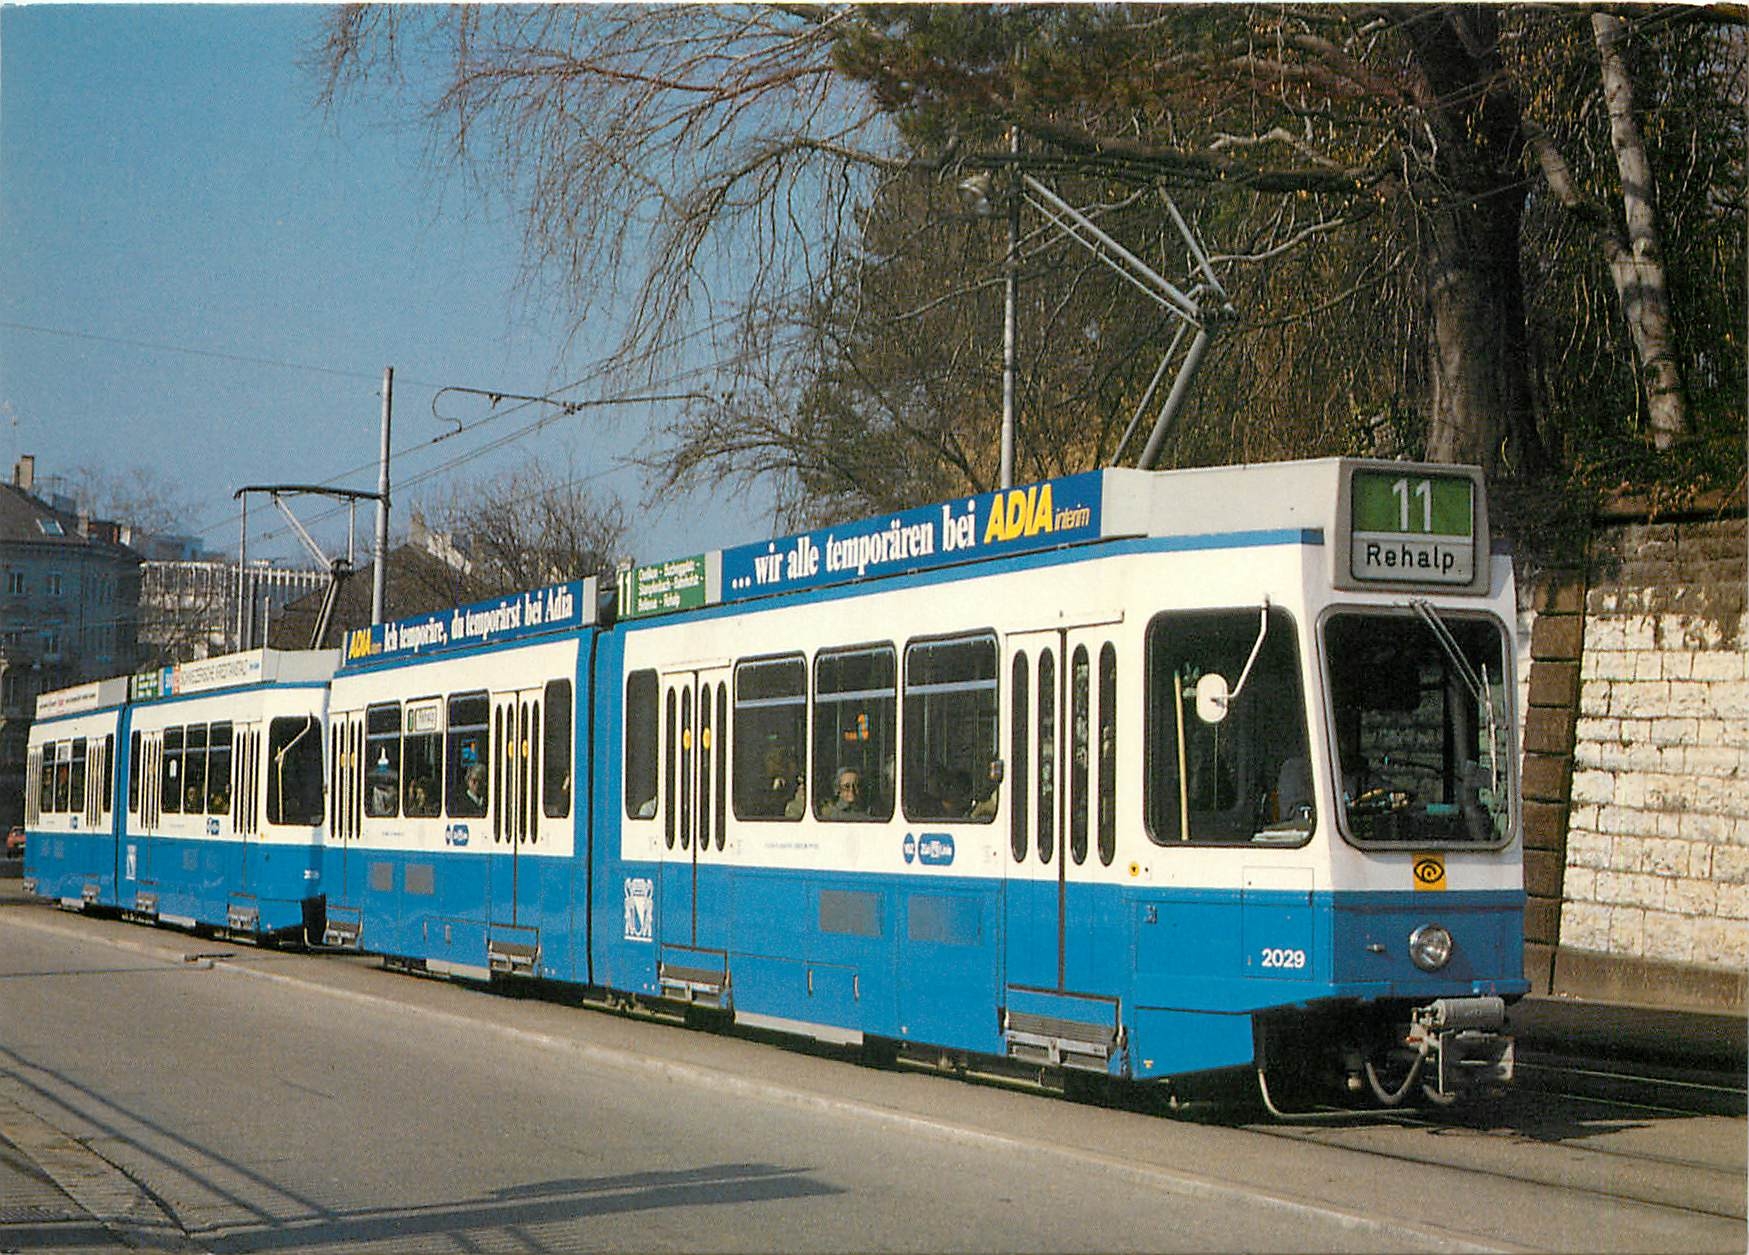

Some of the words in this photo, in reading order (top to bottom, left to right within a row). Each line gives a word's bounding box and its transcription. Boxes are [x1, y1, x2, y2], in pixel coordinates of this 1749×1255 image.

[788, 535, 818, 580] alle
[826, 516, 934, 576] temporären
[942, 500, 976, 552] bei
[984, 483, 1053, 544] ADIA
[1054, 503, 1091, 531] interim
[1392, 478, 1431, 532] 11
[1366, 543, 1454, 575] Rehalp
[384, 623, 398, 652] Ich
[451, 609, 464, 640] du
[524, 591, 542, 626] bei
[546, 586, 573, 621] Adia
[1262, 948, 1306, 968] 2029
